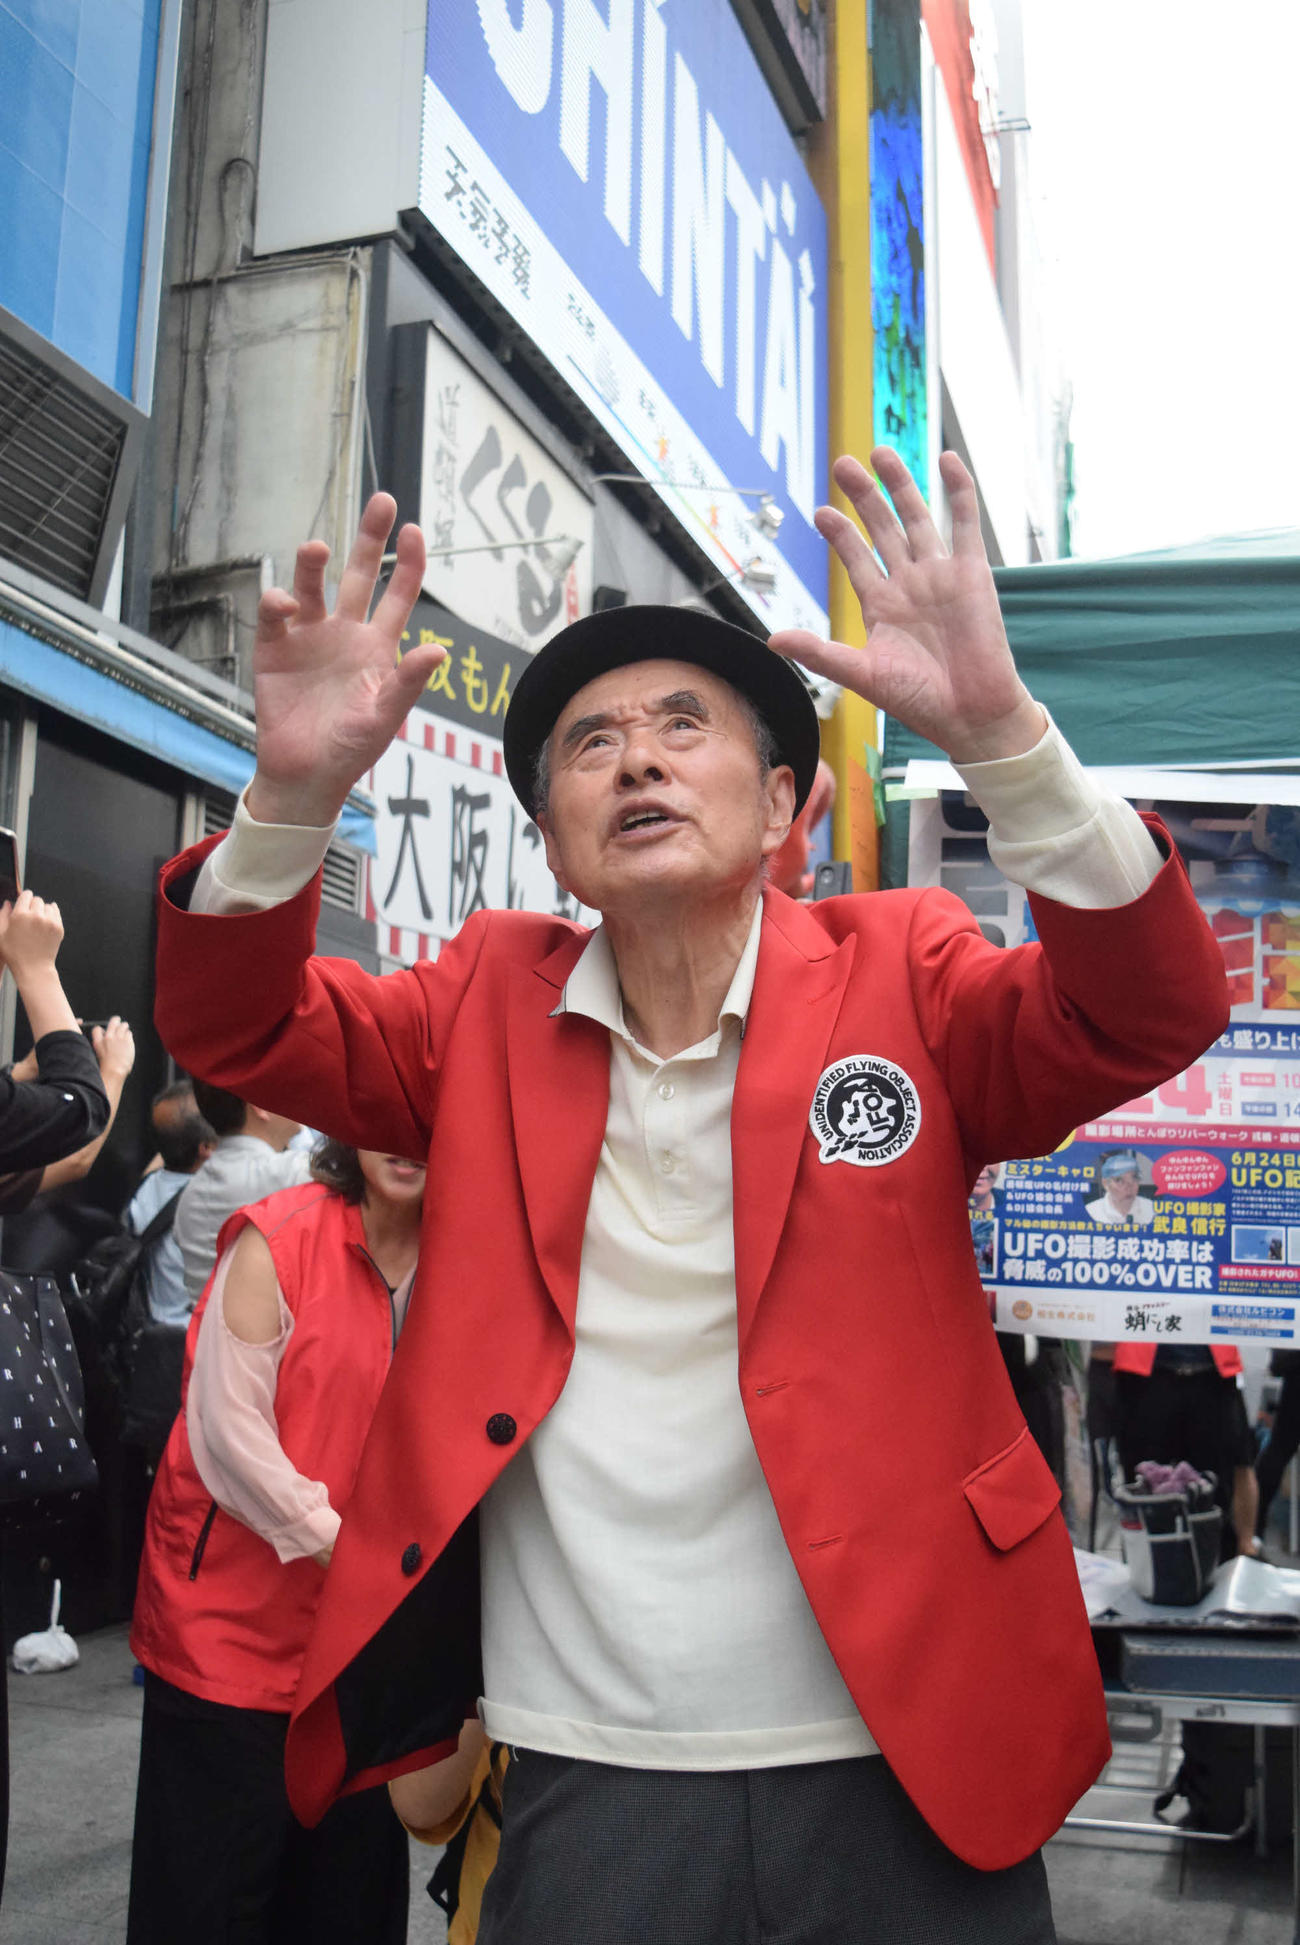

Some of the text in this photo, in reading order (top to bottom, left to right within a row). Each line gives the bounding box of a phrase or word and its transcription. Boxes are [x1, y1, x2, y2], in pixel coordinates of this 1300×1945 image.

[814, 1060, 917, 1161] UNIDENTIFIED FLYING OBJECT ASSOCIATION
[1003, 1231, 1215, 1264] UFO撮影成功率は
[1002, 1258, 1214, 1290] 脅威の100%OVER
